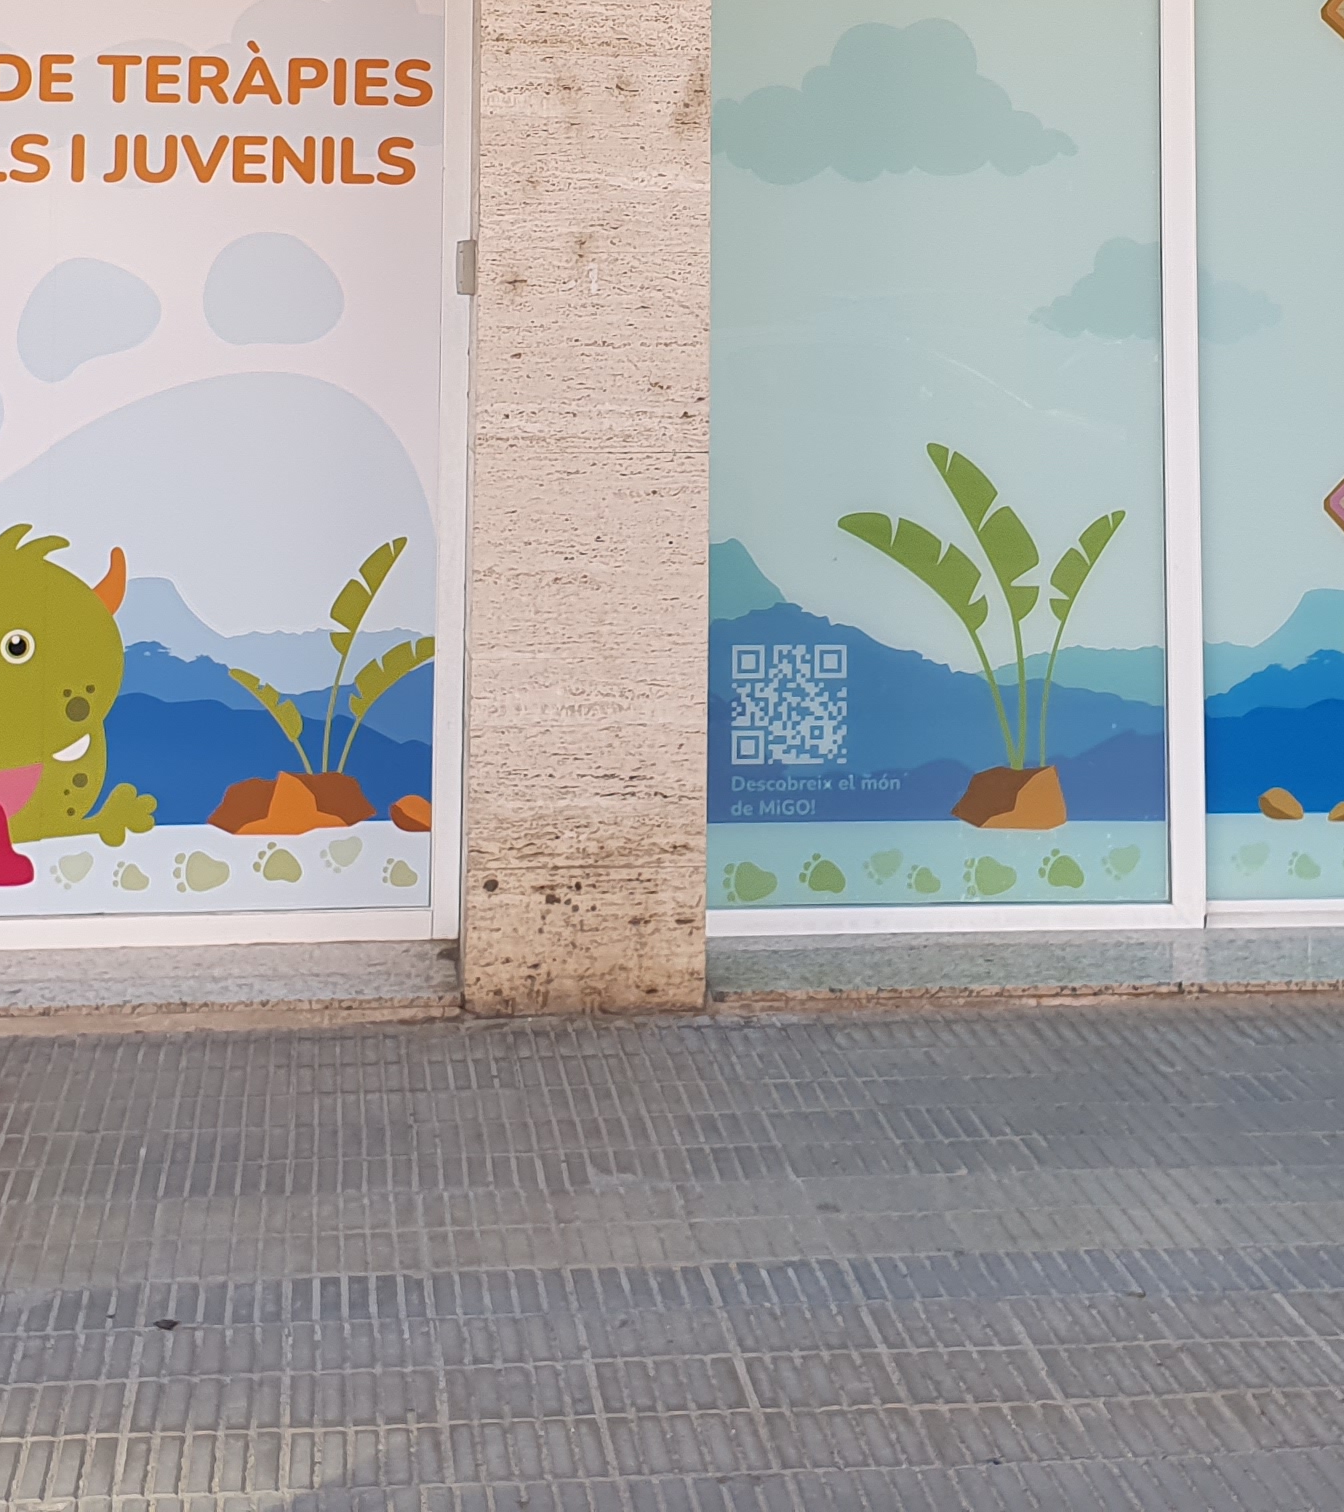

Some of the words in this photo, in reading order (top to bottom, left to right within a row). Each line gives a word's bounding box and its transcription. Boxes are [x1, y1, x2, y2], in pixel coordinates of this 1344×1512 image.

[97, 40, 433, 107] TERÀPIES
[71, 133, 85, 183] I
[103, 134, 417, 186] JUVENILS
[731, 775, 833, 792] Descobreix
[838, 775, 856, 791] el
[861, 774, 901, 791] món
[731, 800, 754, 816] de
